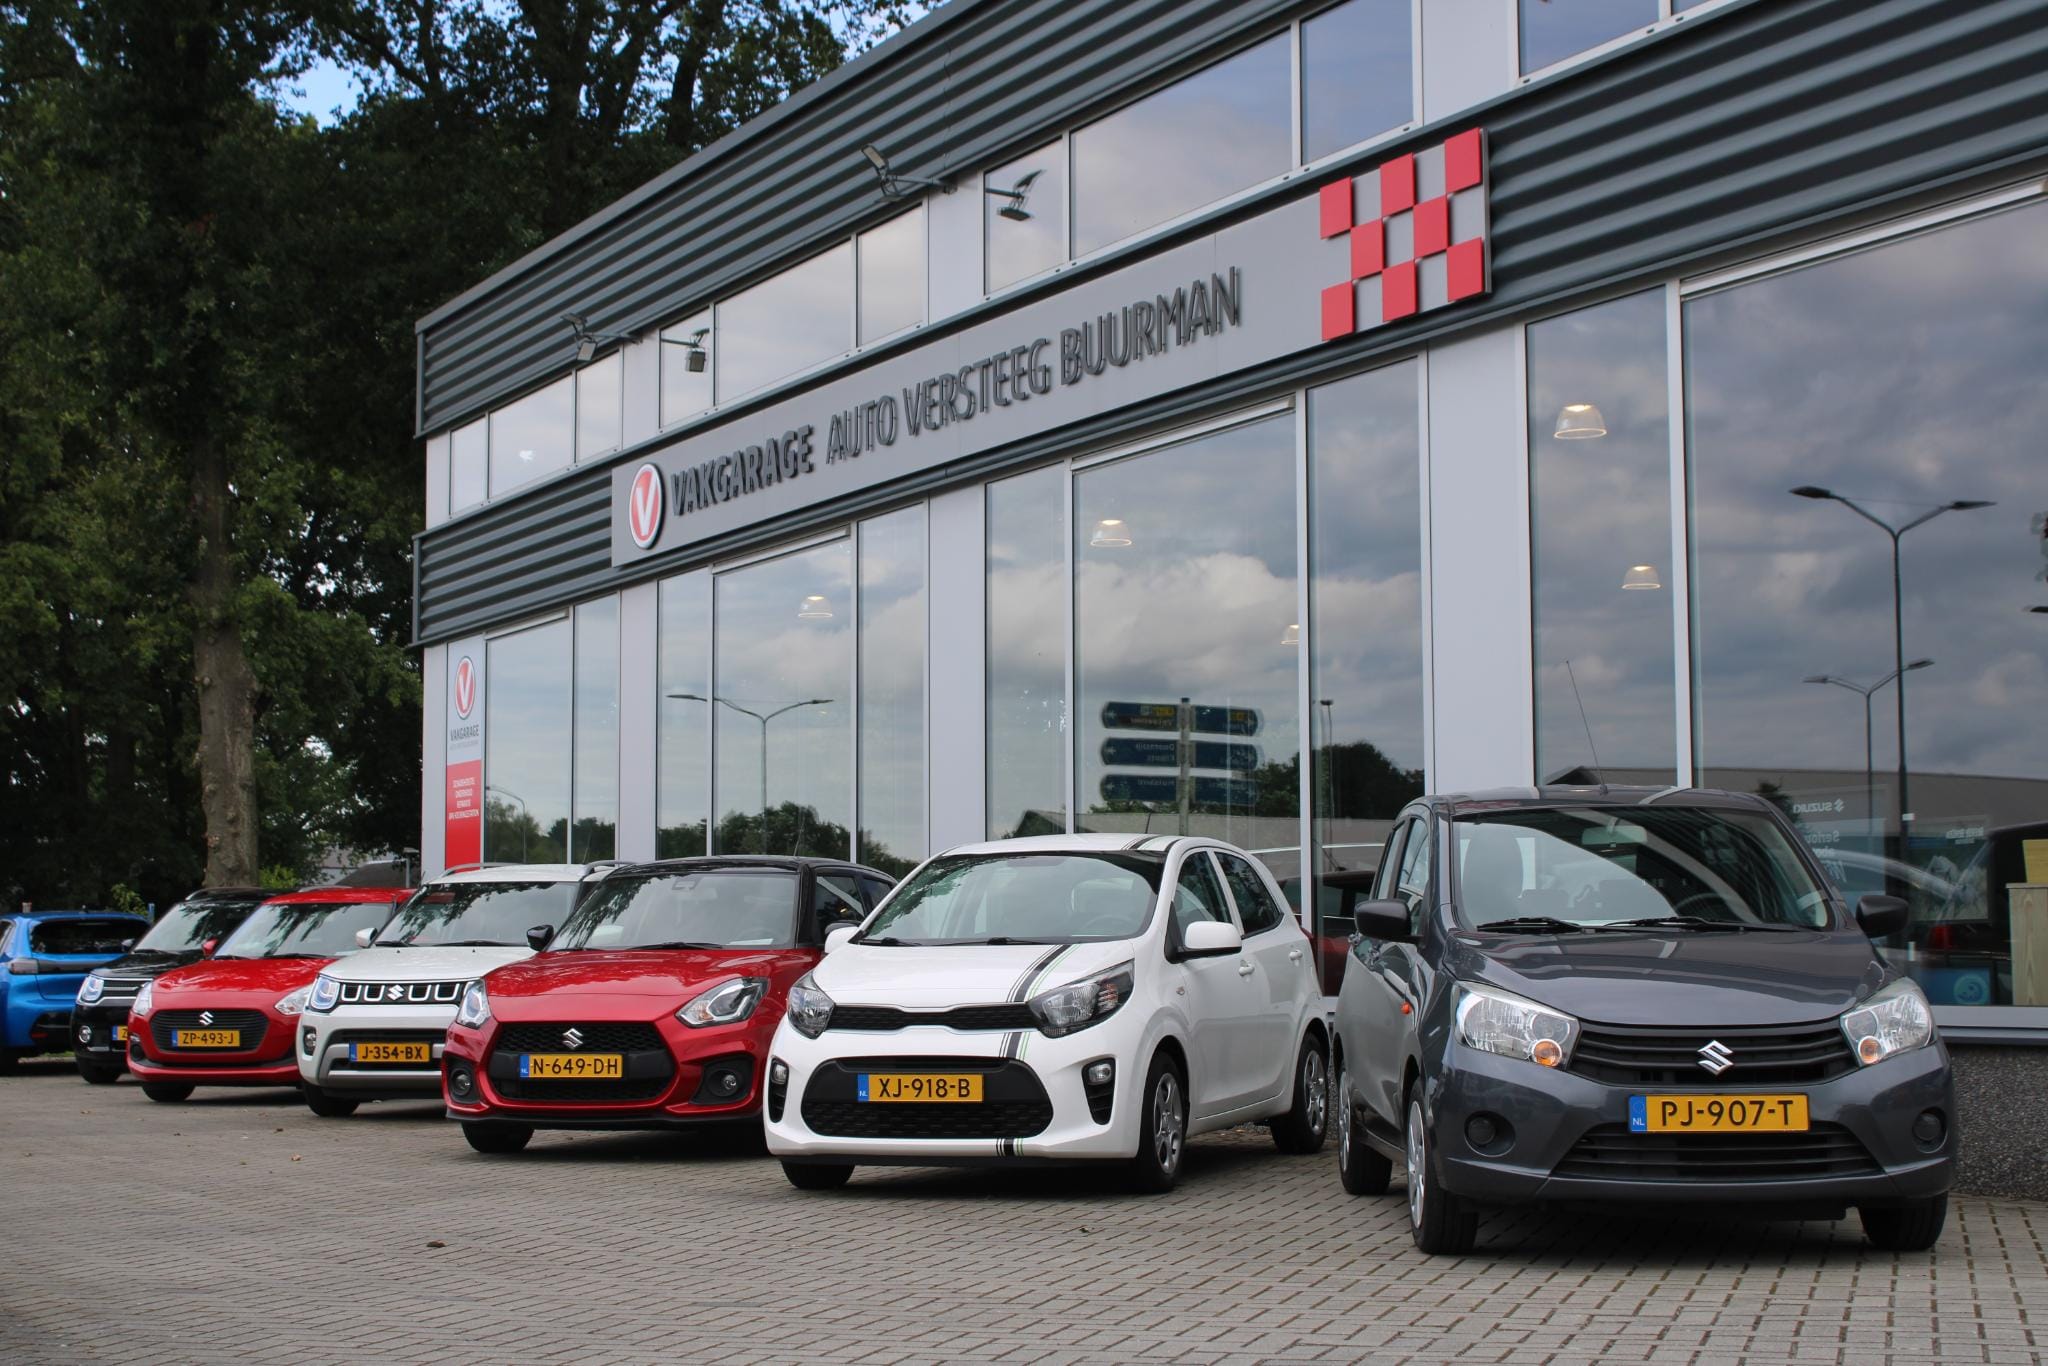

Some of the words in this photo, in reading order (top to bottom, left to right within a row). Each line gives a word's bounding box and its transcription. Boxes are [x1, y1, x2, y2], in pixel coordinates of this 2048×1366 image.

[670, 424, 815, 517] VAKGARAGE
[825, 395, 898, 465] AUTO
[902, 338, 1050, 437] VERSTEEG
[1060, 266, 1243, 386] BUURMAN
[182, 1032, 234, 1045] ZP-493-J
[362, 1046, 423, 1060] J-354-BX
[533, 1058, 618, 1074] N-649-DH
[879, 1078, 970, 1098] XJ-918-B
[1632, 1117, 1645, 1126] NL
[1661, 1100, 1793, 1126] PJ-907-T
